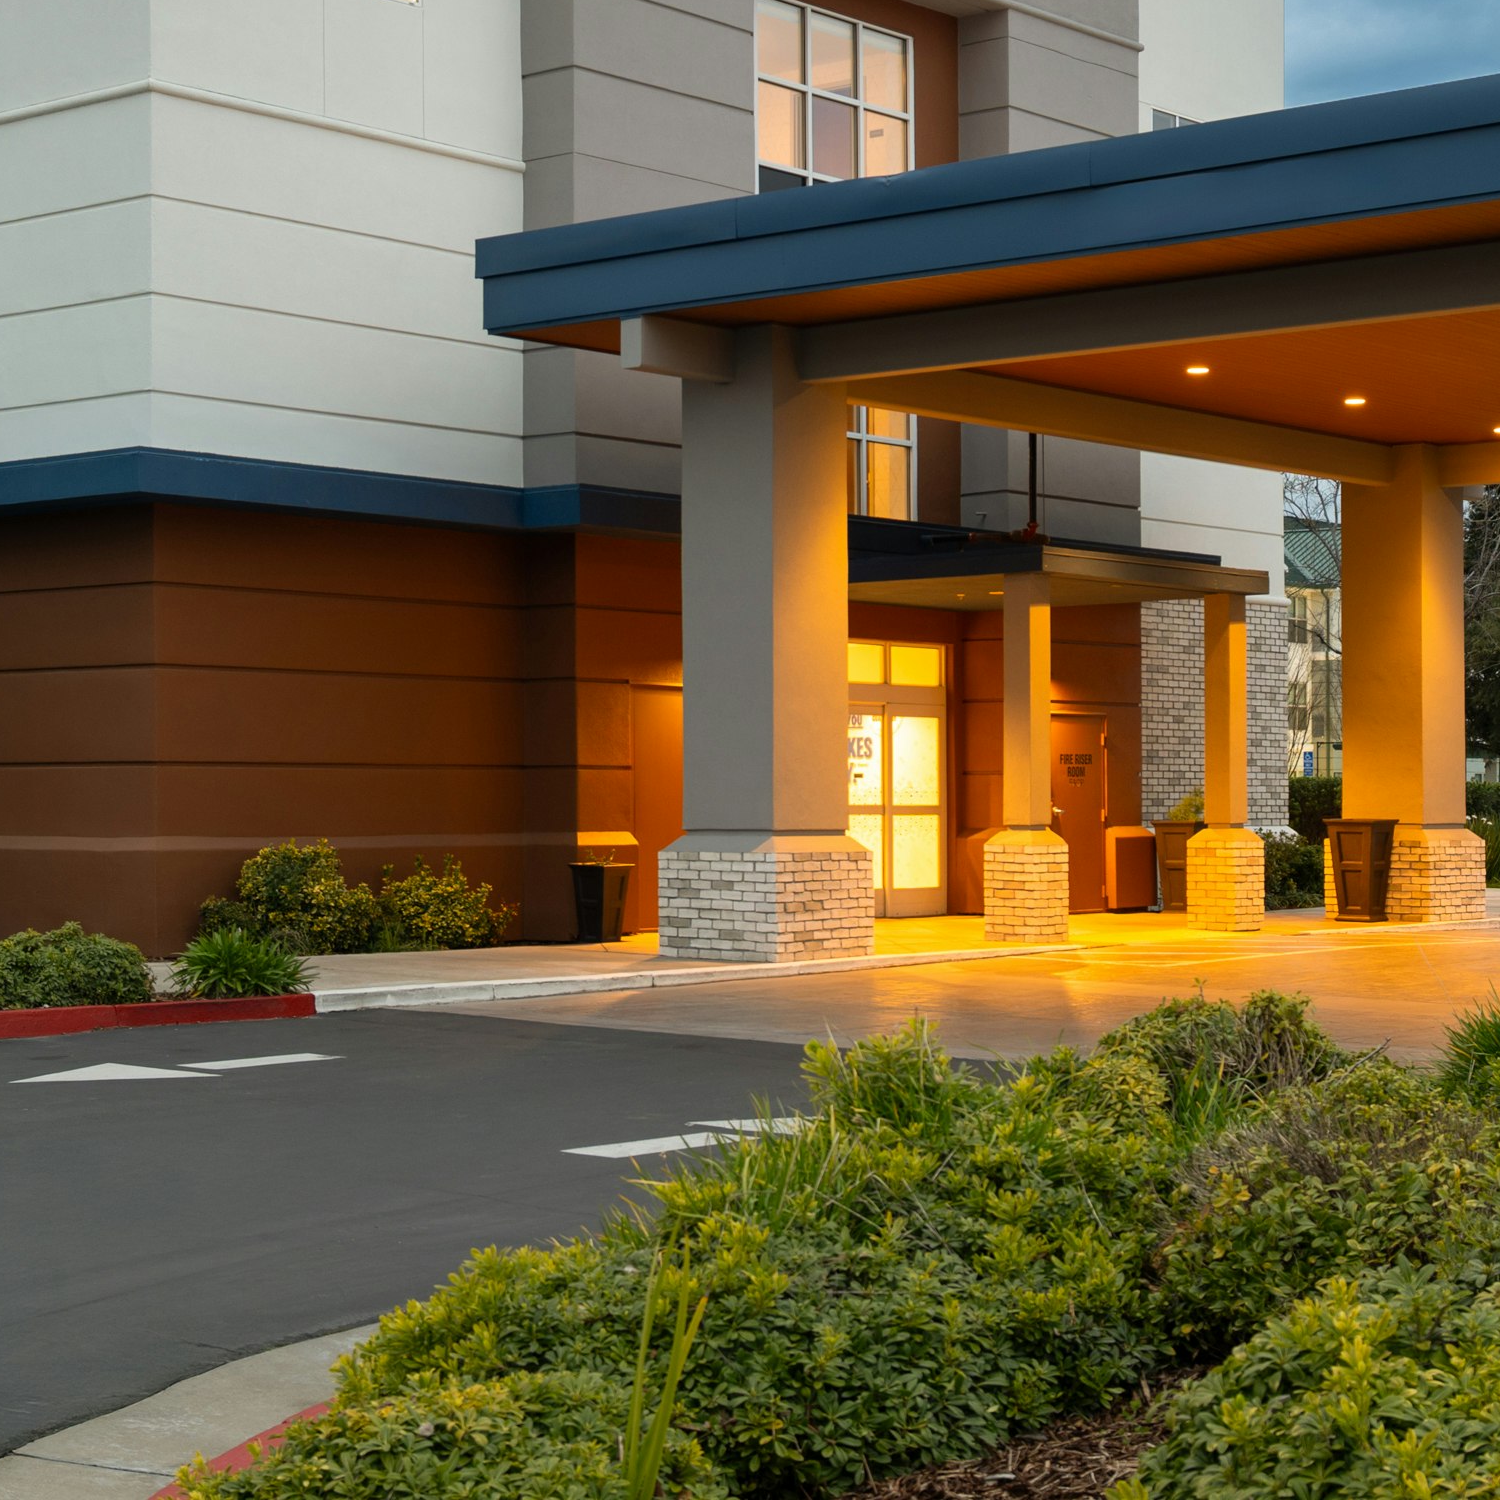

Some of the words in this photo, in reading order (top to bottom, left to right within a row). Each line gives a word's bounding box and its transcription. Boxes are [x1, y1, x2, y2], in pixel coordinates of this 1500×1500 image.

[1060, 754, 1074, 765] FIRE
[1075, 754, 1092, 765] RISER
[1067, 766, 1086, 777] ROOM
